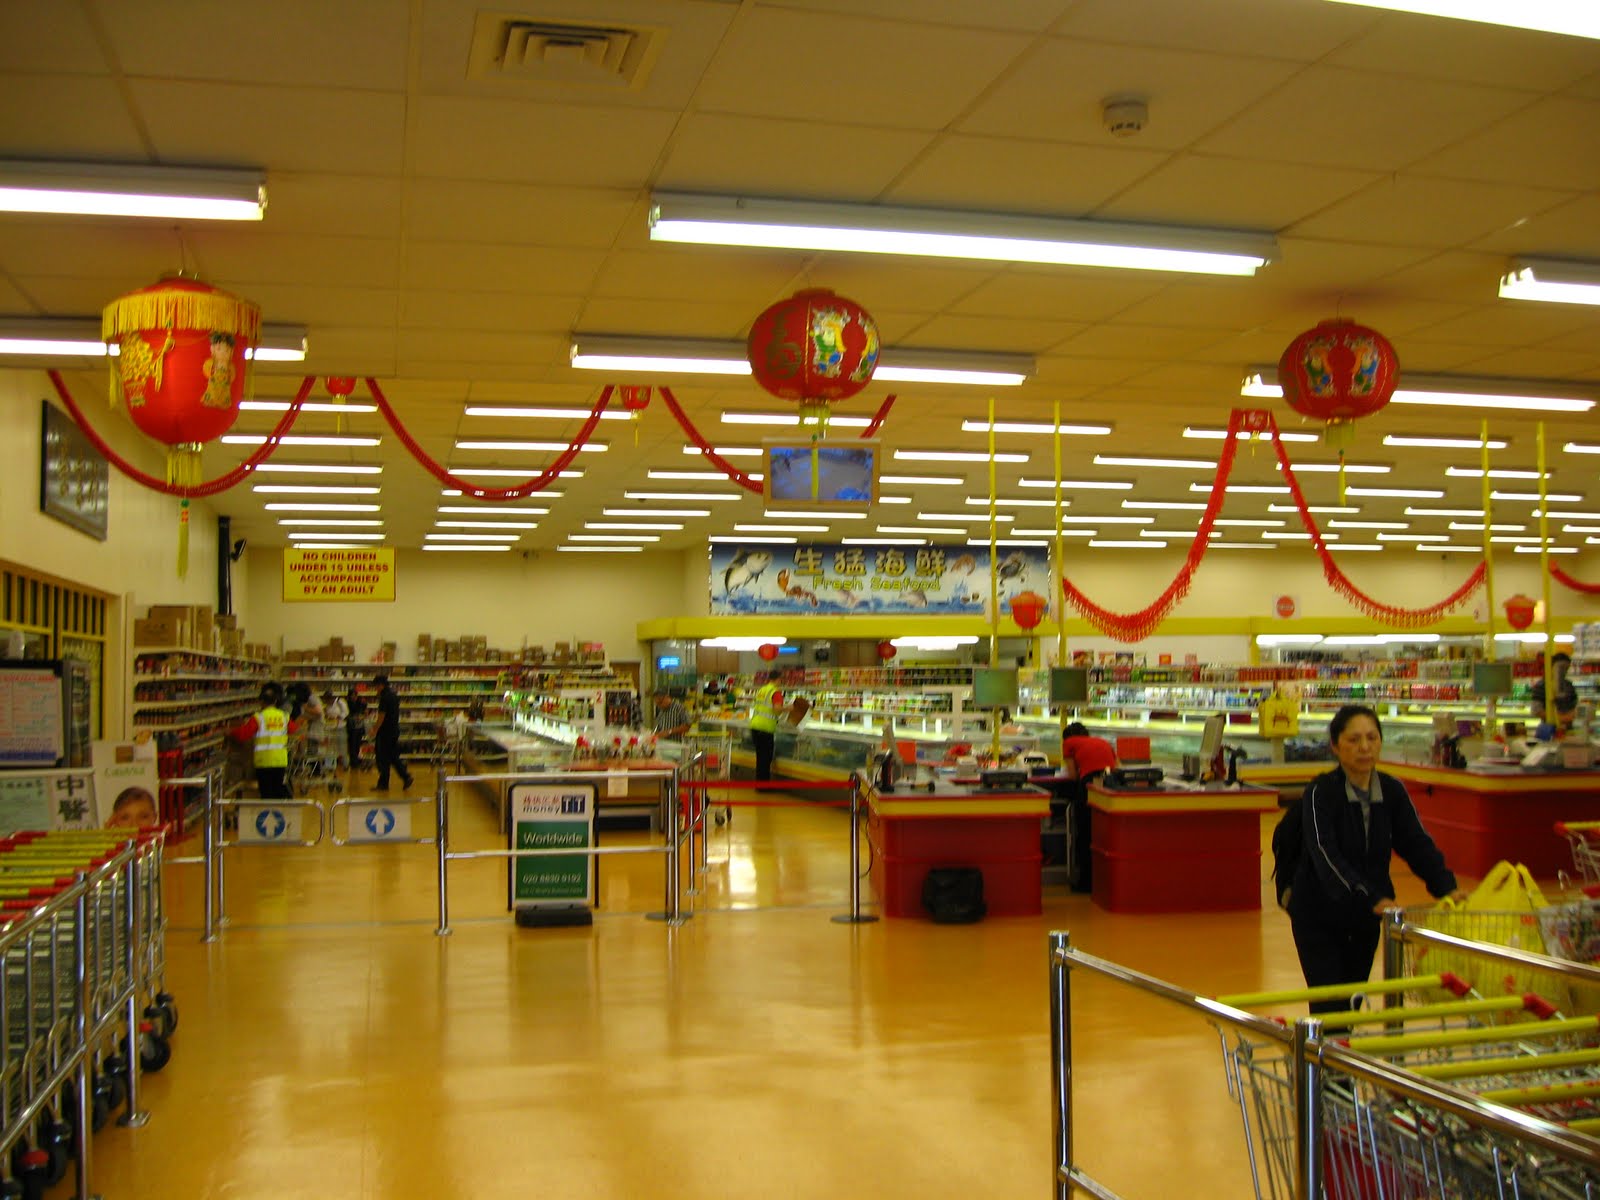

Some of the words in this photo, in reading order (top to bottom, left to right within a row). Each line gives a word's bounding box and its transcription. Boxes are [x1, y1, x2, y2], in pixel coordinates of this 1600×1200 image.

[303, 552, 318, 561] NO
[322, 552, 377, 561] CHILDREN
[793, 547, 948, 577] 生猛海鮮
[290, 563, 327, 572] UNDER
[347, 563, 389, 573] UNLESS
[300, 574, 379, 583] ACCOMPANIED
[813, 576, 863, 591] Fresh
[870, 576, 941, 591] Seafood
[304, 585, 317, 594] BY
[321, 585, 336, 594] AN
[340, 585, 375, 594] ADULT
[596, 690, 603, 704] 2
[523, 806, 560, 815] money
[524, 832, 583, 844] Worldwide
